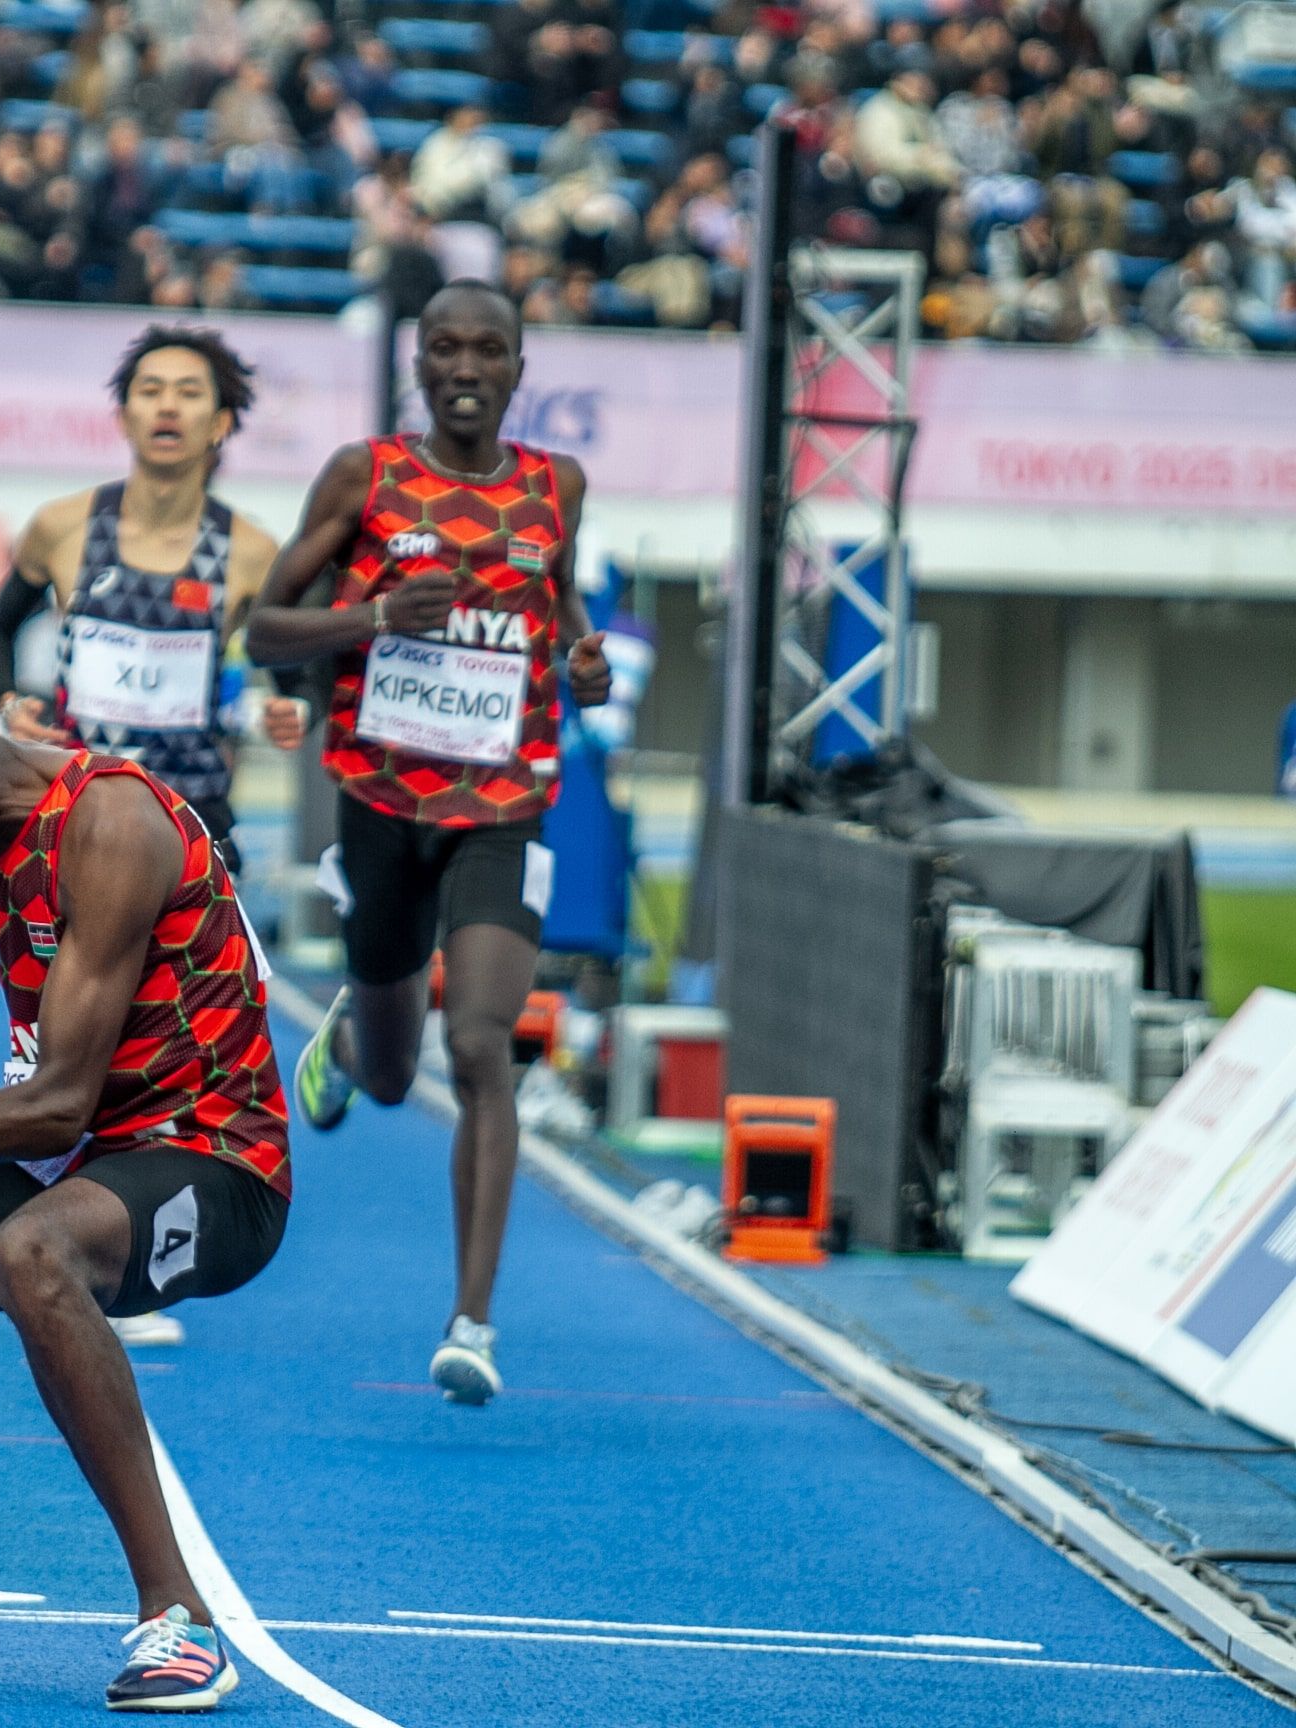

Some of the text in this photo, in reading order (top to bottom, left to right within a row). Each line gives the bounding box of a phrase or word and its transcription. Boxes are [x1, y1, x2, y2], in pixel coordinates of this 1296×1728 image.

[422, 607, 529, 650] NYA
[114, 661, 164, 692] XU
[456, 653, 520, 676] TOYOTA
[372, 671, 514, 721] KIPKEMOI
[153, 1227, 192, 1263] 4
